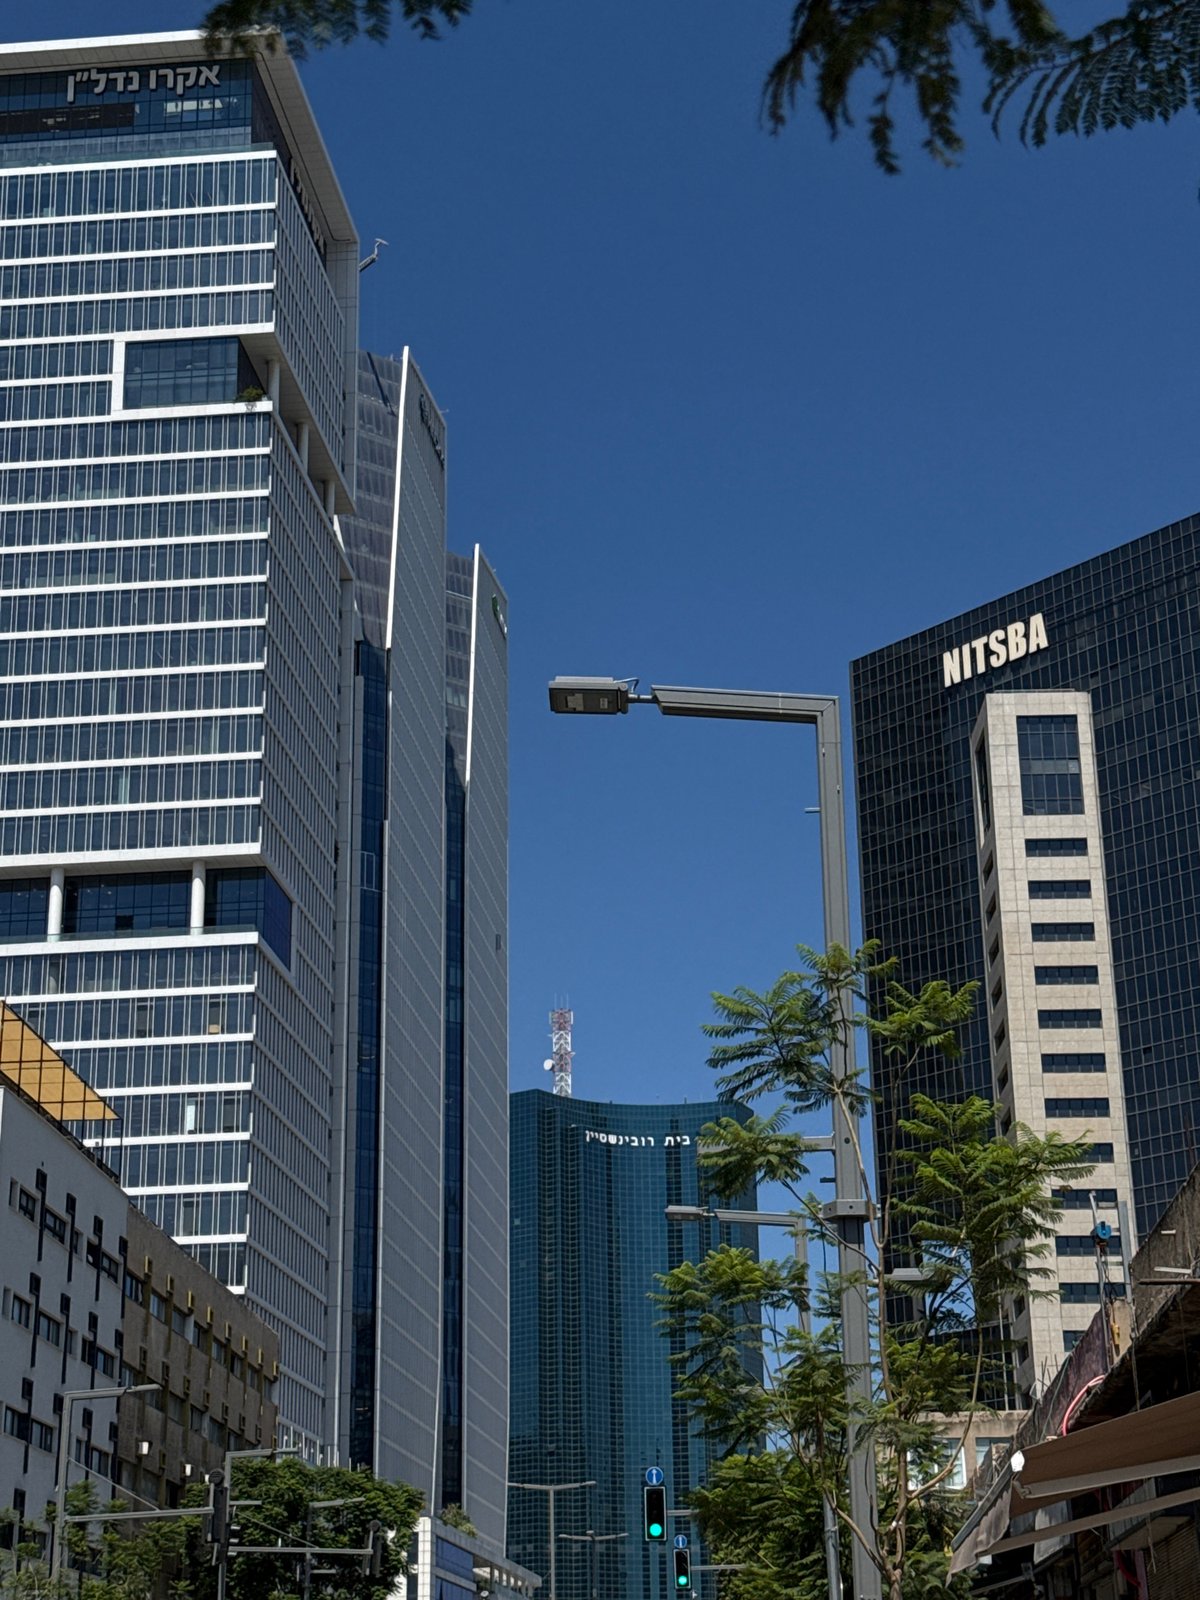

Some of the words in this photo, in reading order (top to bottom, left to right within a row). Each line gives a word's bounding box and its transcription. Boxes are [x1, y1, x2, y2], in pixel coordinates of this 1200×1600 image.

[149, 65, 220, 95] אקרו
[942, 612, 1049, 688] NITSBA
[664, 1135, 691, 1146] בית
